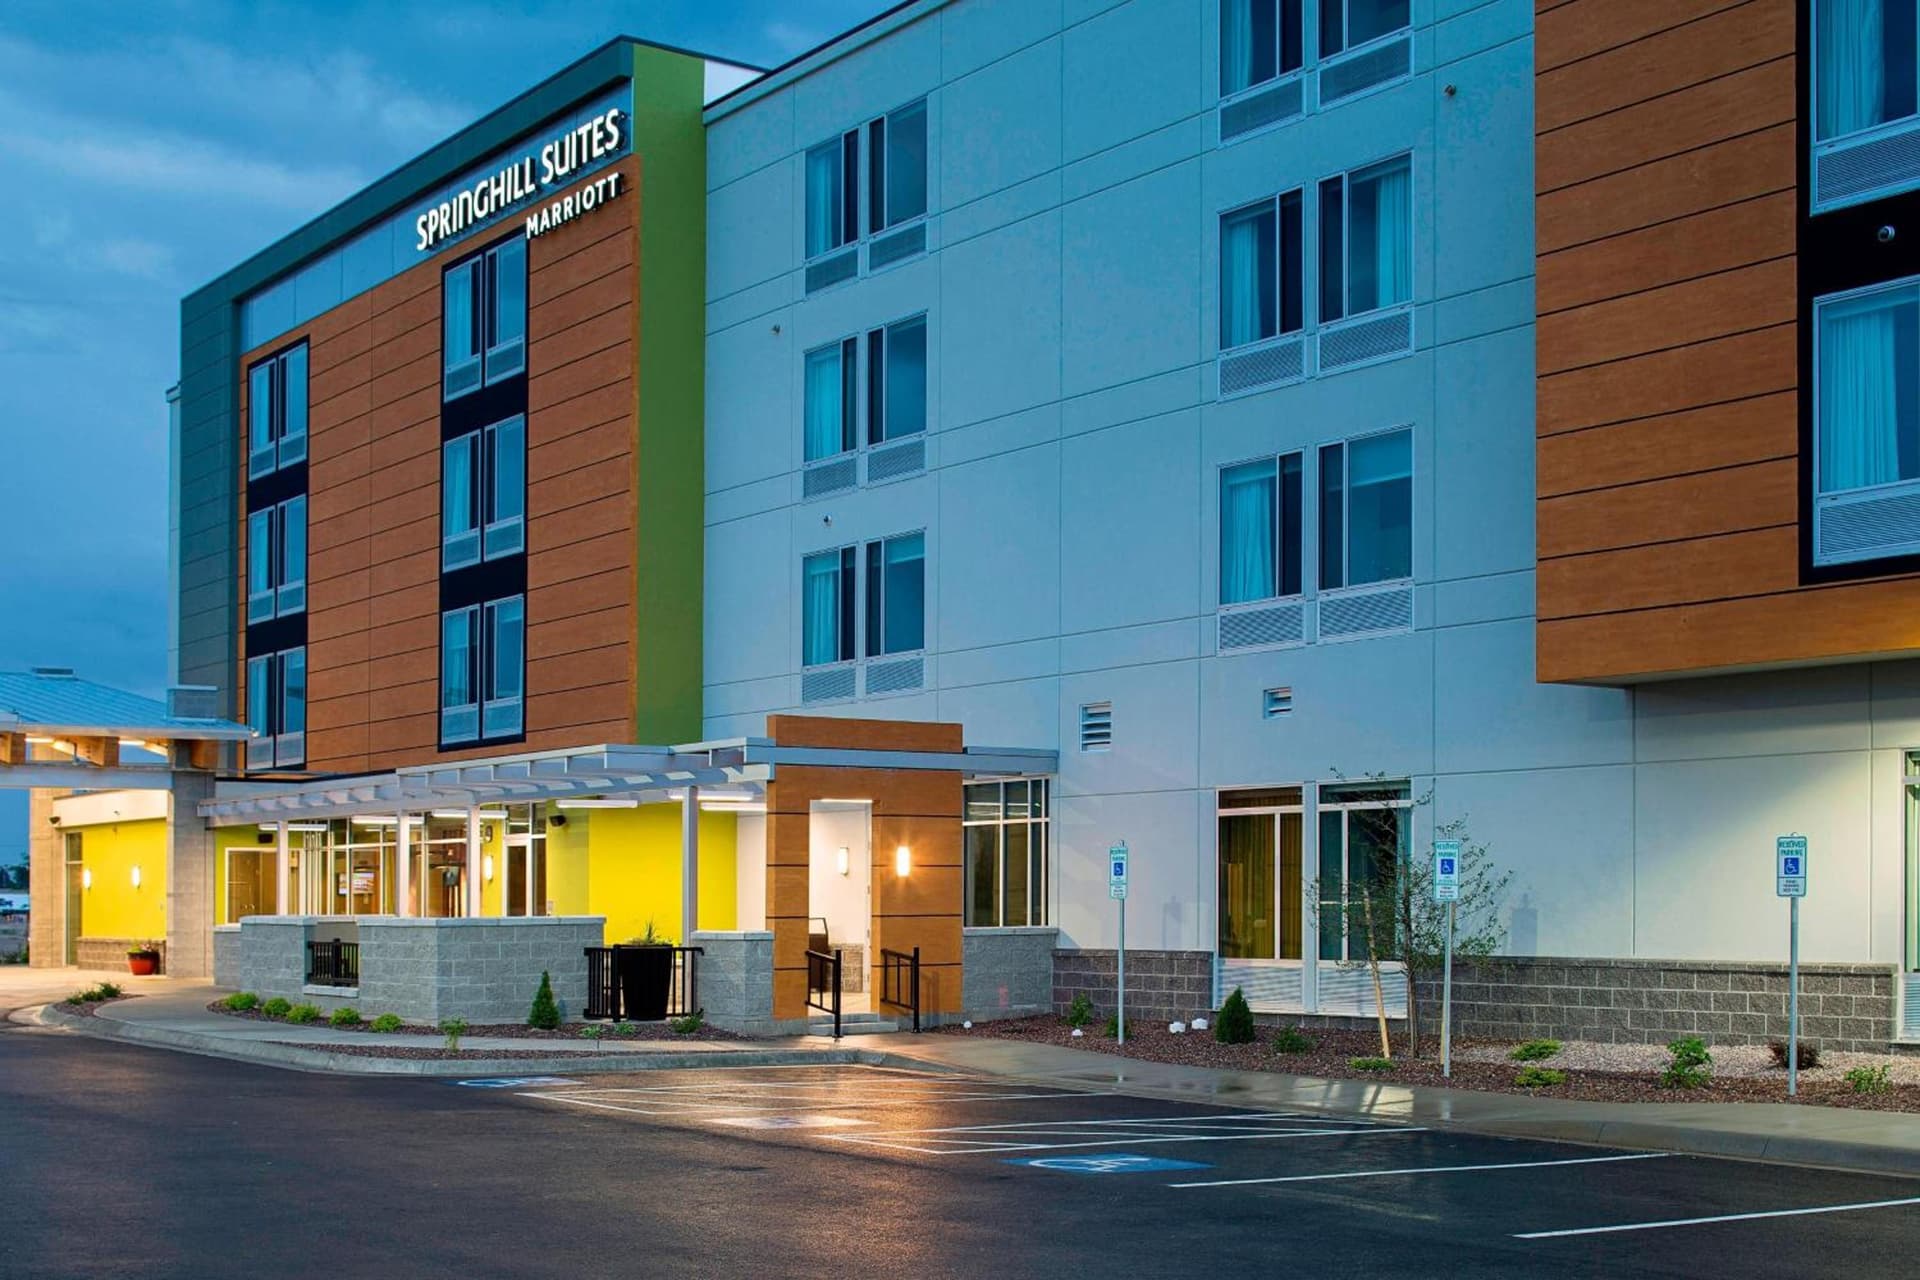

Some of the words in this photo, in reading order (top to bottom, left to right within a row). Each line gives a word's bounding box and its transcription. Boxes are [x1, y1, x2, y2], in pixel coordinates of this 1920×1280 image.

[417, 157, 536, 250] SPRINGHILL
[541, 108, 620, 184] SUITES
[526, 172, 620, 239] MARRIOTT
